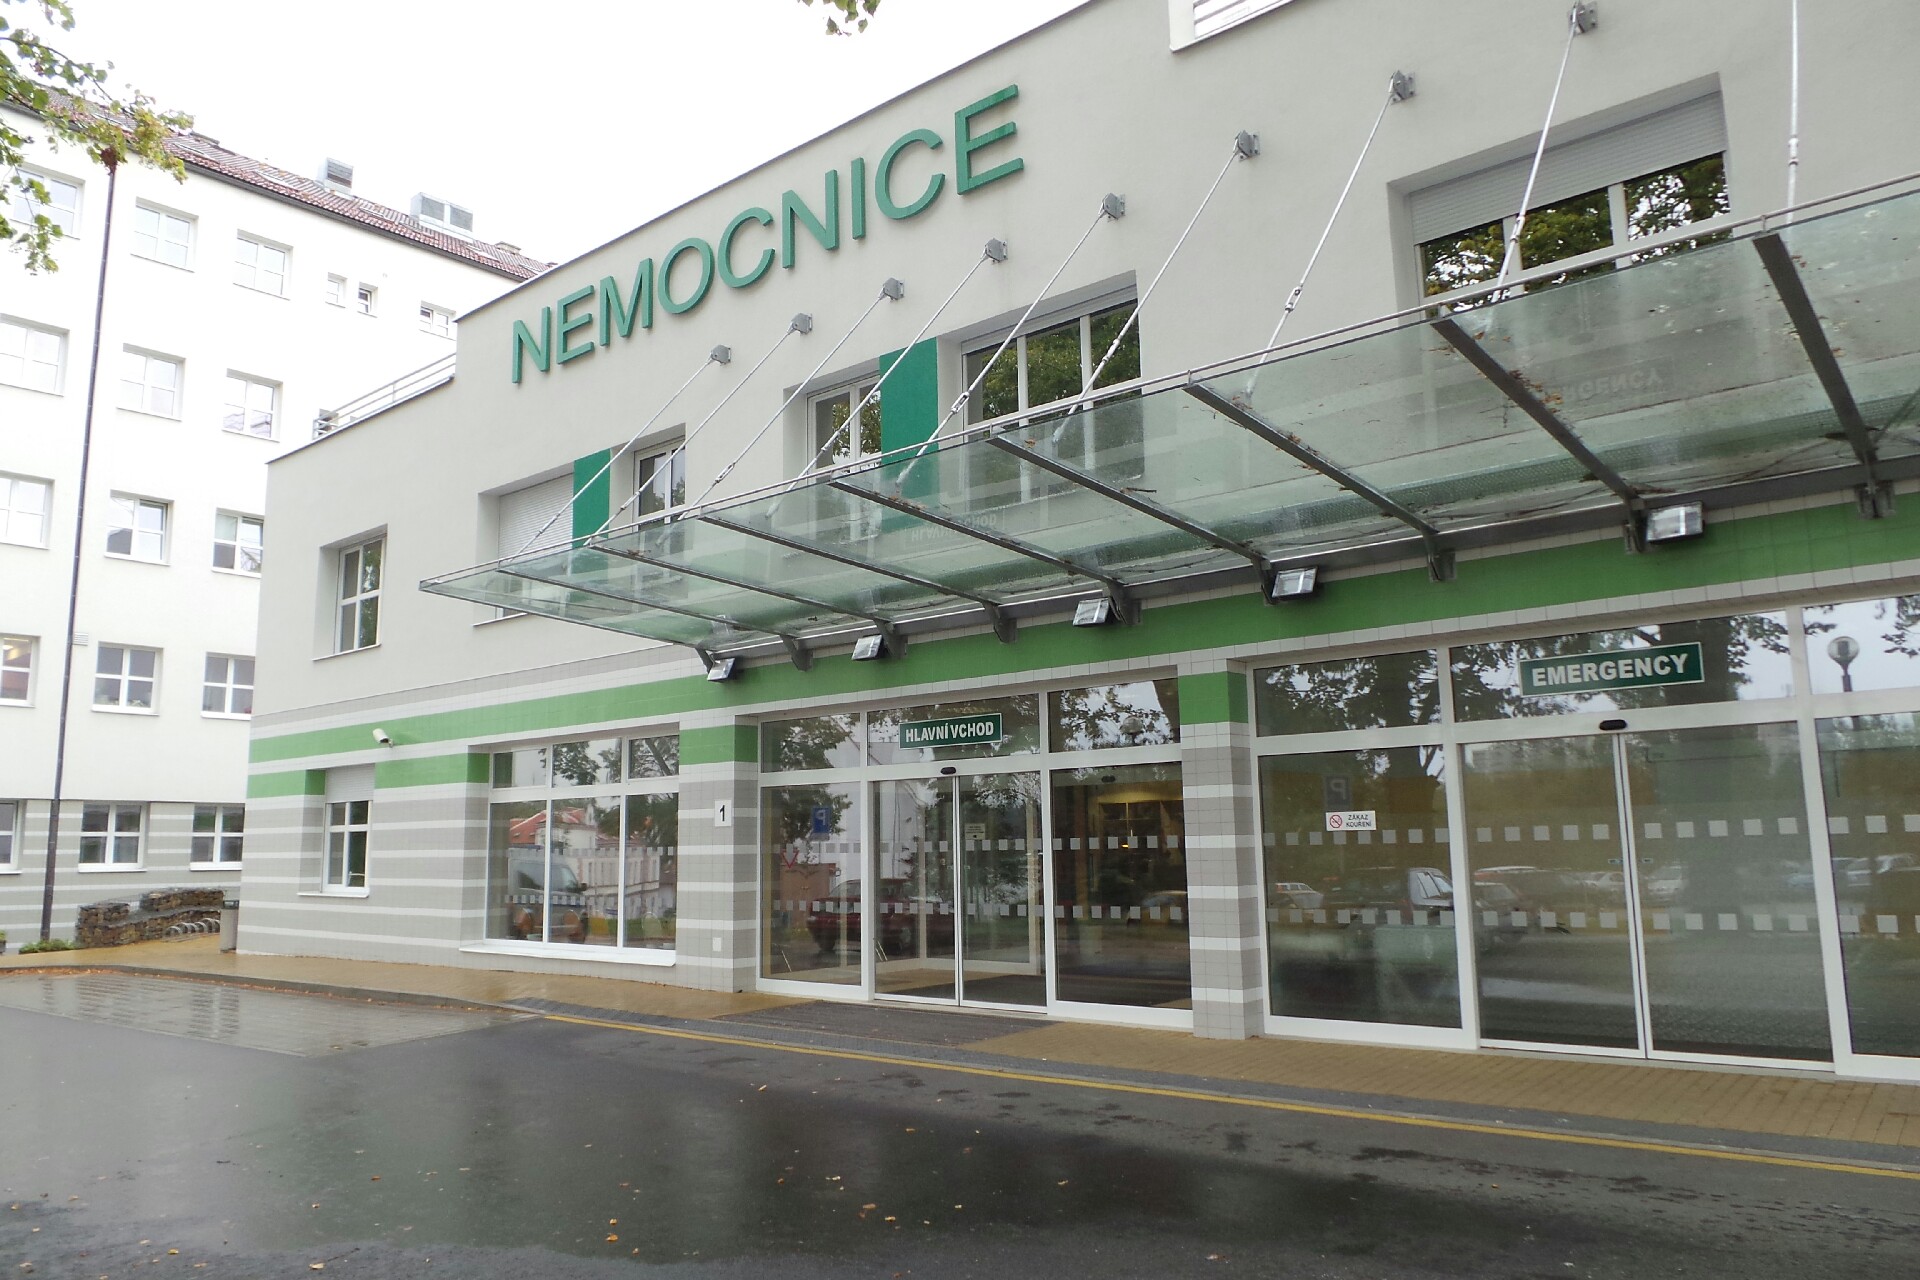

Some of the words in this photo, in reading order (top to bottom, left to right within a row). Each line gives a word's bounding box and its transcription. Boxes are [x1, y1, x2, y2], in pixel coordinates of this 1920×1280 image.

[511, 84, 1023, 383] NEMOCNICE
[1532, 653, 1688, 687] EMERGENCY
[905, 722, 949, 743] HLAVNÍ
[950, 721, 994, 739] VCHOD
[719, 804, 726, 822] 1
